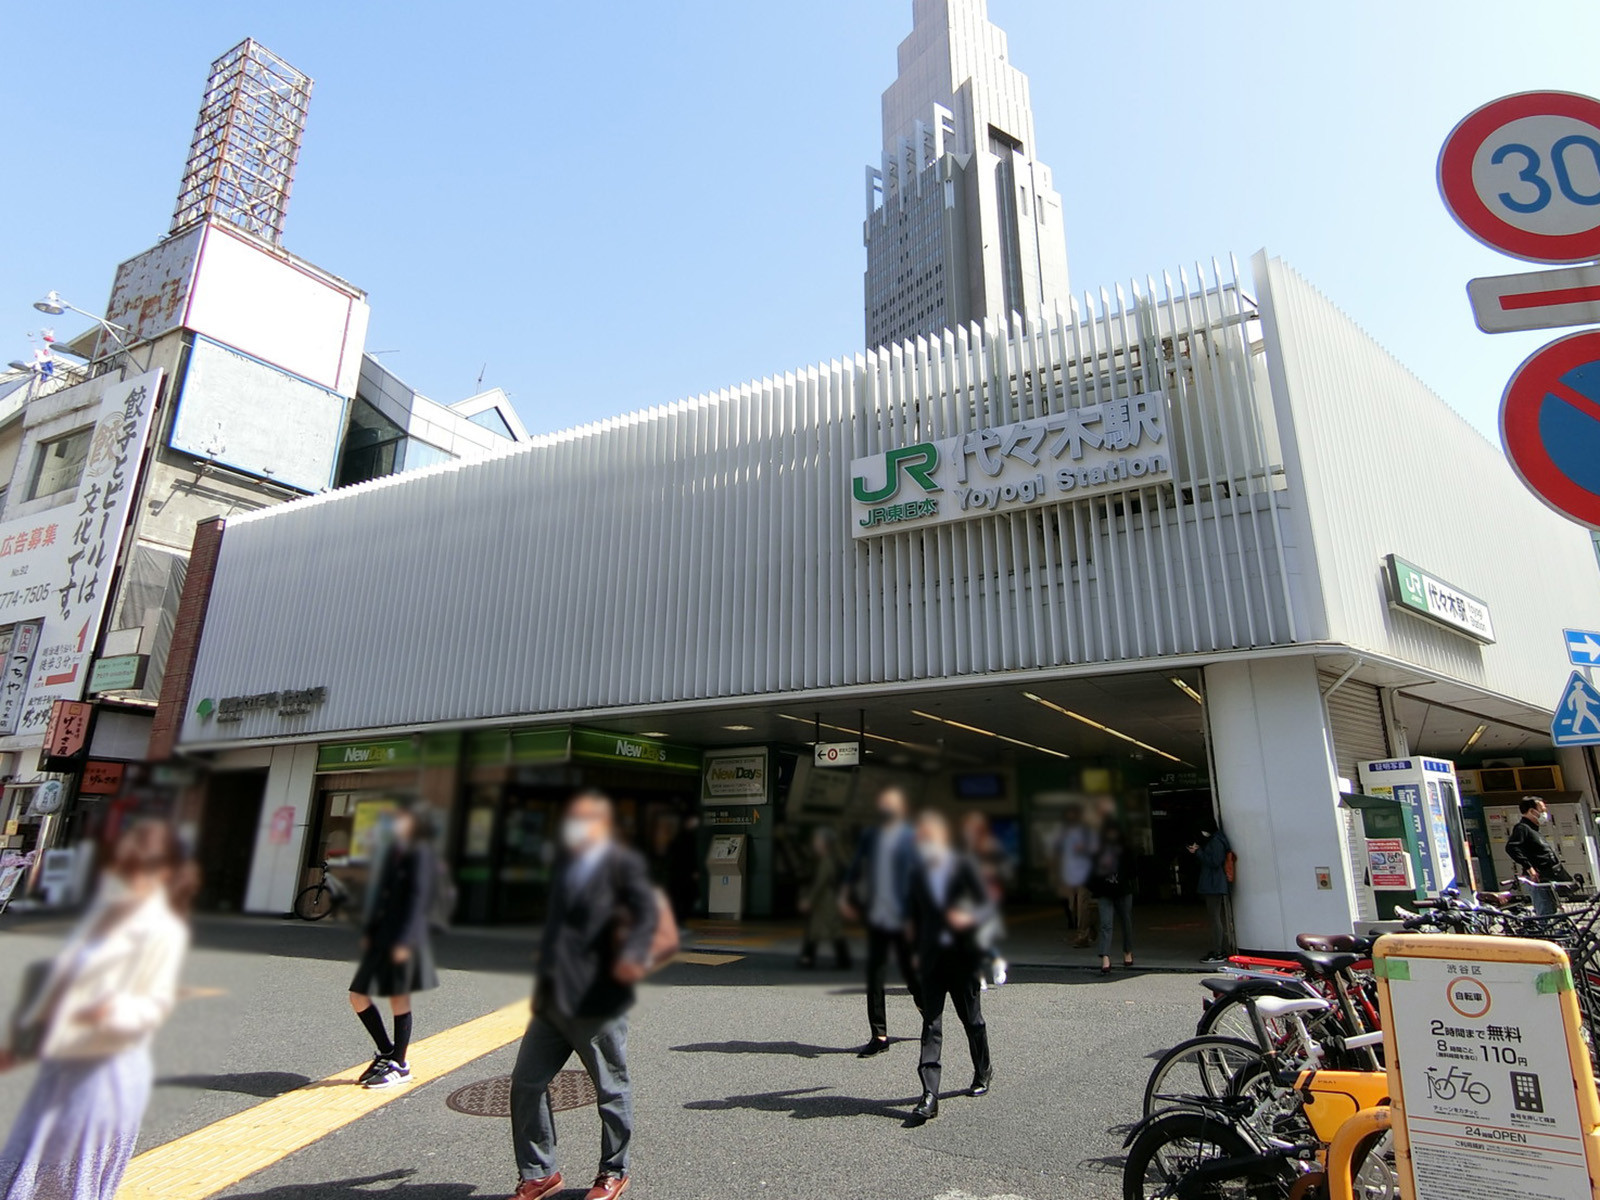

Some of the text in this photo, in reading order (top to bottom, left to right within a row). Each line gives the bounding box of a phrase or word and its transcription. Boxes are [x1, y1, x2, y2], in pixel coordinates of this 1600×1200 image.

[1490, 135, 1600, 213] 30
[952, 393, 1163, 484] 代々木駅
[853, 442, 942, 504] JR
[955, 454, 1167, 510] Yoyogi Station
[78, 386, 146, 603] 餃子とビールは
[859, 498, 937, 527] JR東日本
[0, 523, 59, 557] 広告募集
[0, 583, 51, 609] 774-7505
[1405, 572, 1422, 597] JR
[1428, 582, 1468, 623] 代々木駅
[7, 656, 28, 694] つちや
[711, 767, 763, 780] NewDays
[1447, 964, 1482, 975] 渋谷区
[1455, 992, 1483, 1001] 自転車
[1431, 1020, 1522, 1043] 2時間まで無料
